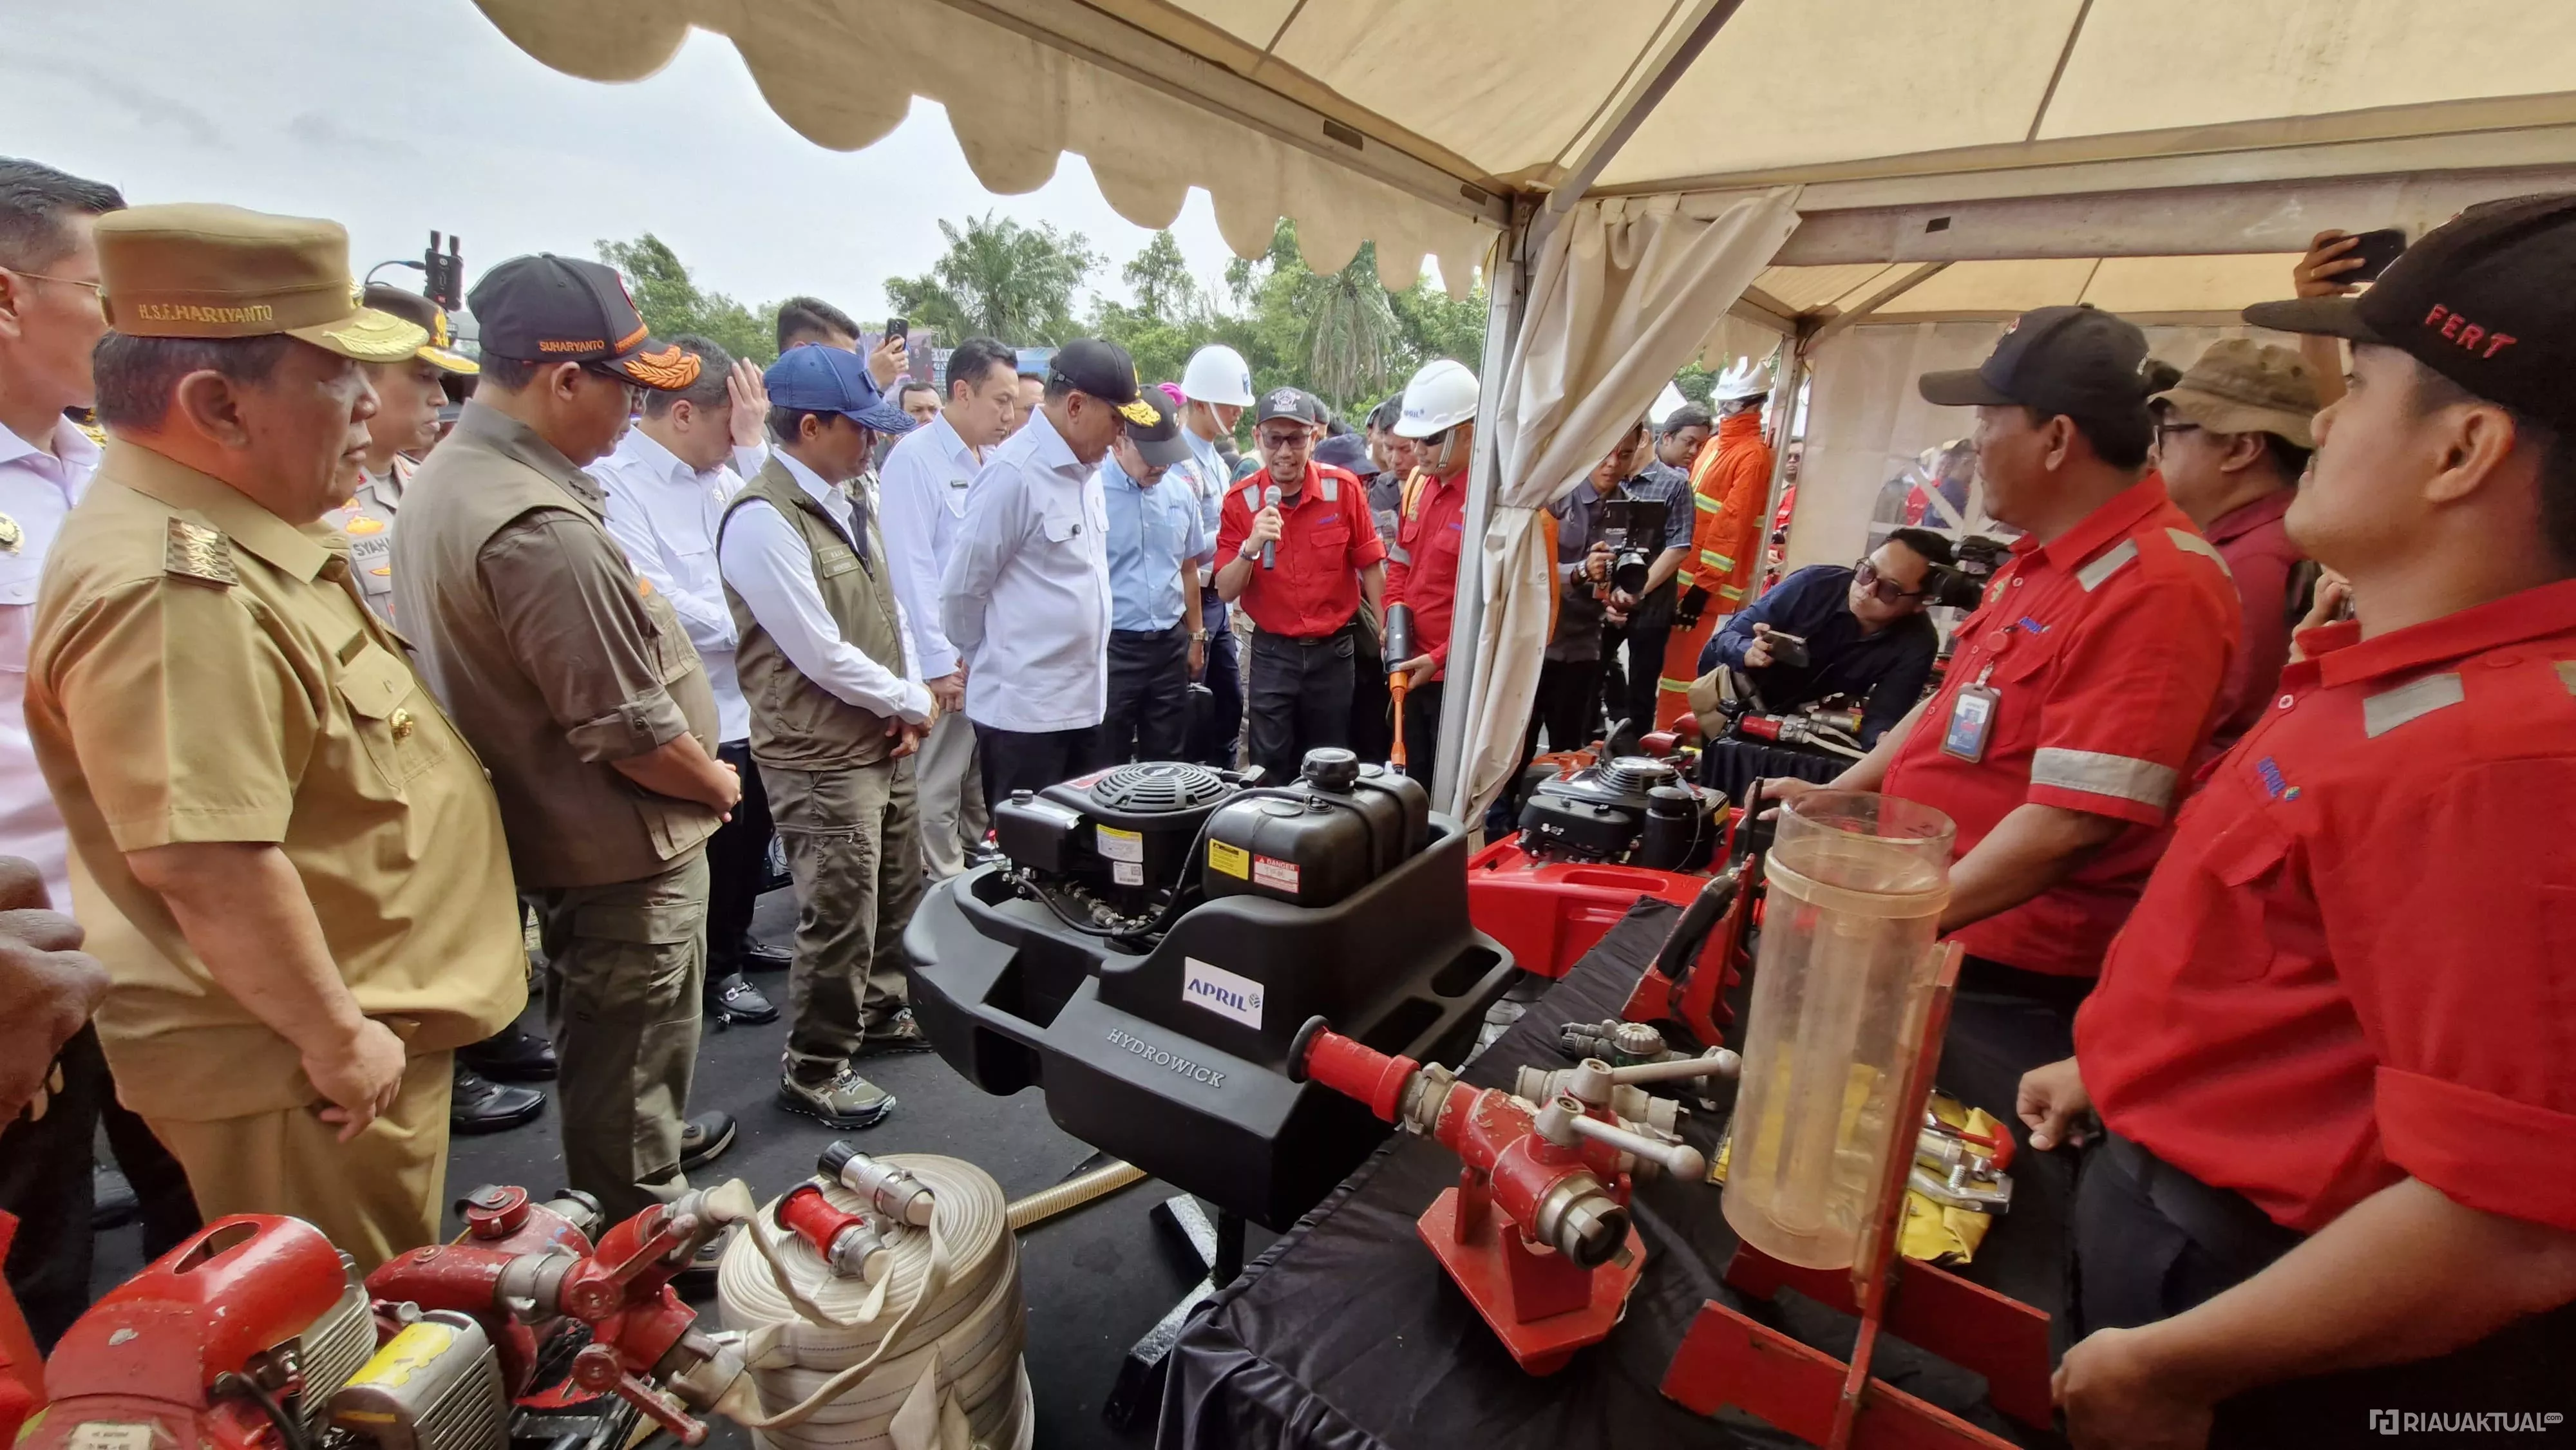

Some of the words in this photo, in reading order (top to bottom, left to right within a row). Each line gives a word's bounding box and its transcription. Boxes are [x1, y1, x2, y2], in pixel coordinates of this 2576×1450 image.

[539, 340, 605, 352] SUHARYANTO
[2425, 303, 2517, 358] FERT
[1266, 858, 1295, 871] DANGER
[1187, 978, 1247, 1012] APRIL
[1106, 1028, 1226, 1088] HYDROWICK
